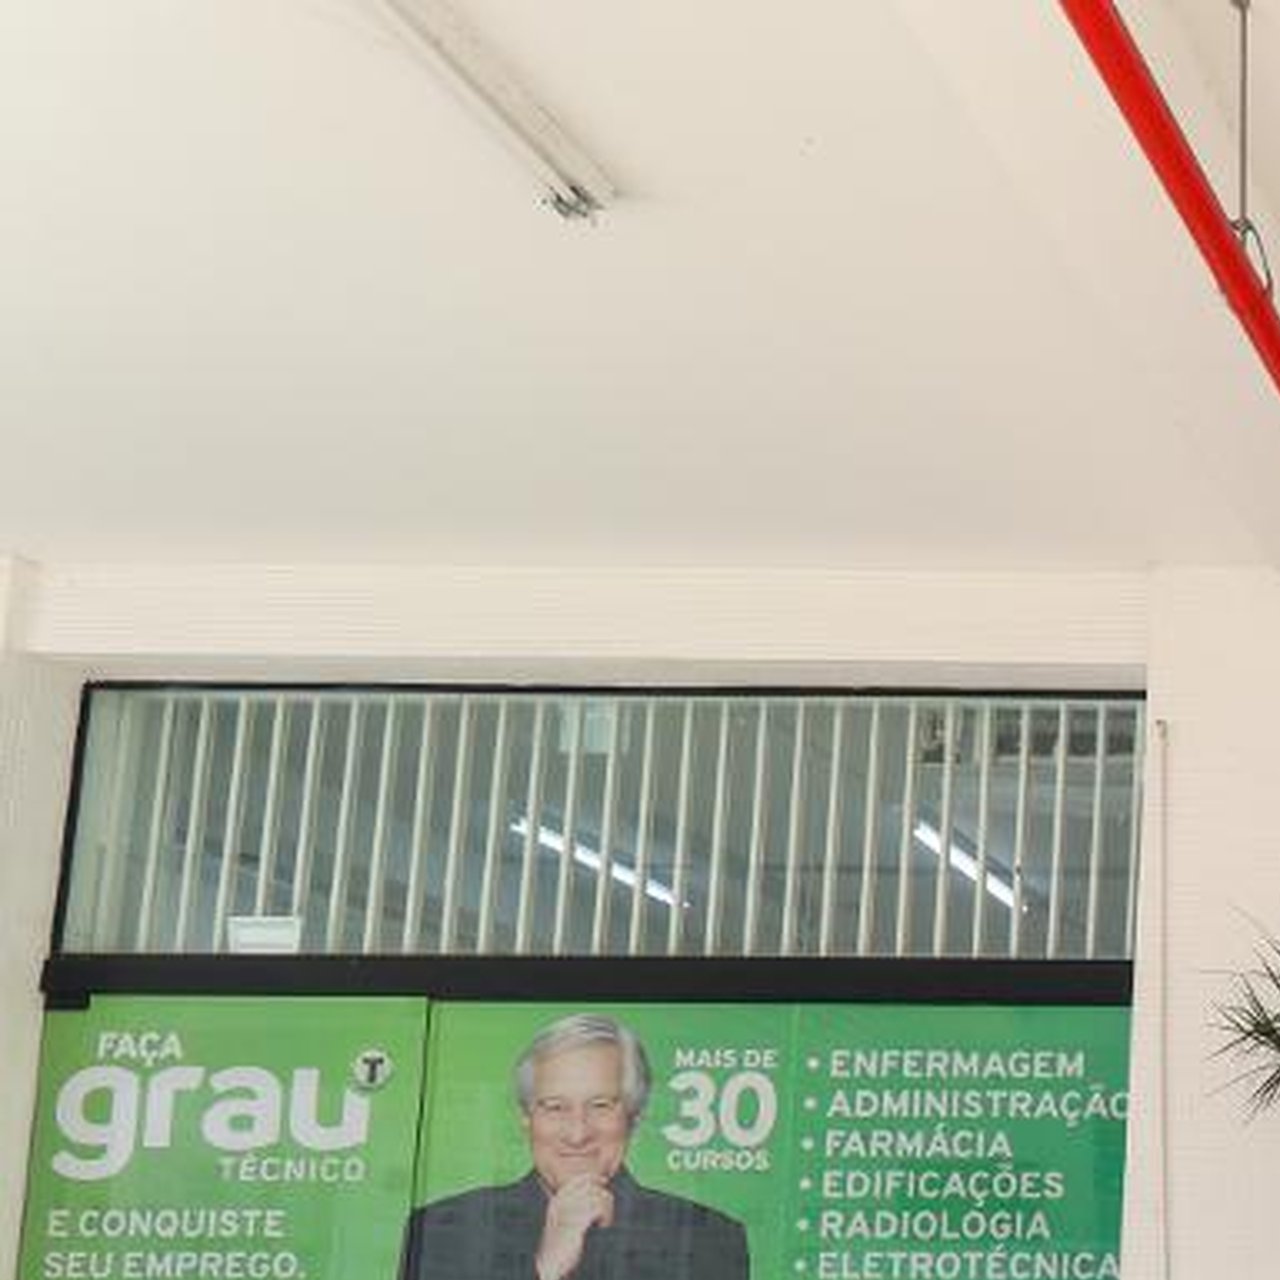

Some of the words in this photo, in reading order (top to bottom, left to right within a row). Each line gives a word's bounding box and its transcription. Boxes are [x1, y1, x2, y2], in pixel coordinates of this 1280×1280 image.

[99, 1032, 184, 1066] FAÇA
[675, 1048, 737, 1069] MAIS
[742, 1048, 778, 1069] DE
[830, 1050, 1085, 1078] ENFERMAGEM
[52, 1064, 370, 1180] grau
[661, 1070, 777, 1148] 30
[825, 1123, 1013, 1157] FARMÁCIA
[217, 1153, 366, 1182] TÉCNICO
[667, 1149, 770, 1171] CURSOS
[821, 1161, 1065, 1207] EDIFICAÇÕES
[47, 1210, 70, 1239] E
[79, 1208, 287, 1240] CONQUISTE
[819, 1210, 1051, 1240] RADIOLOGIA
[42, 1252, 110, 1279] SEU
[122, 1250, 306, 1280] EMPREGO.
[817, 1244, 1121, 1280] ELETROTÉCNICA
